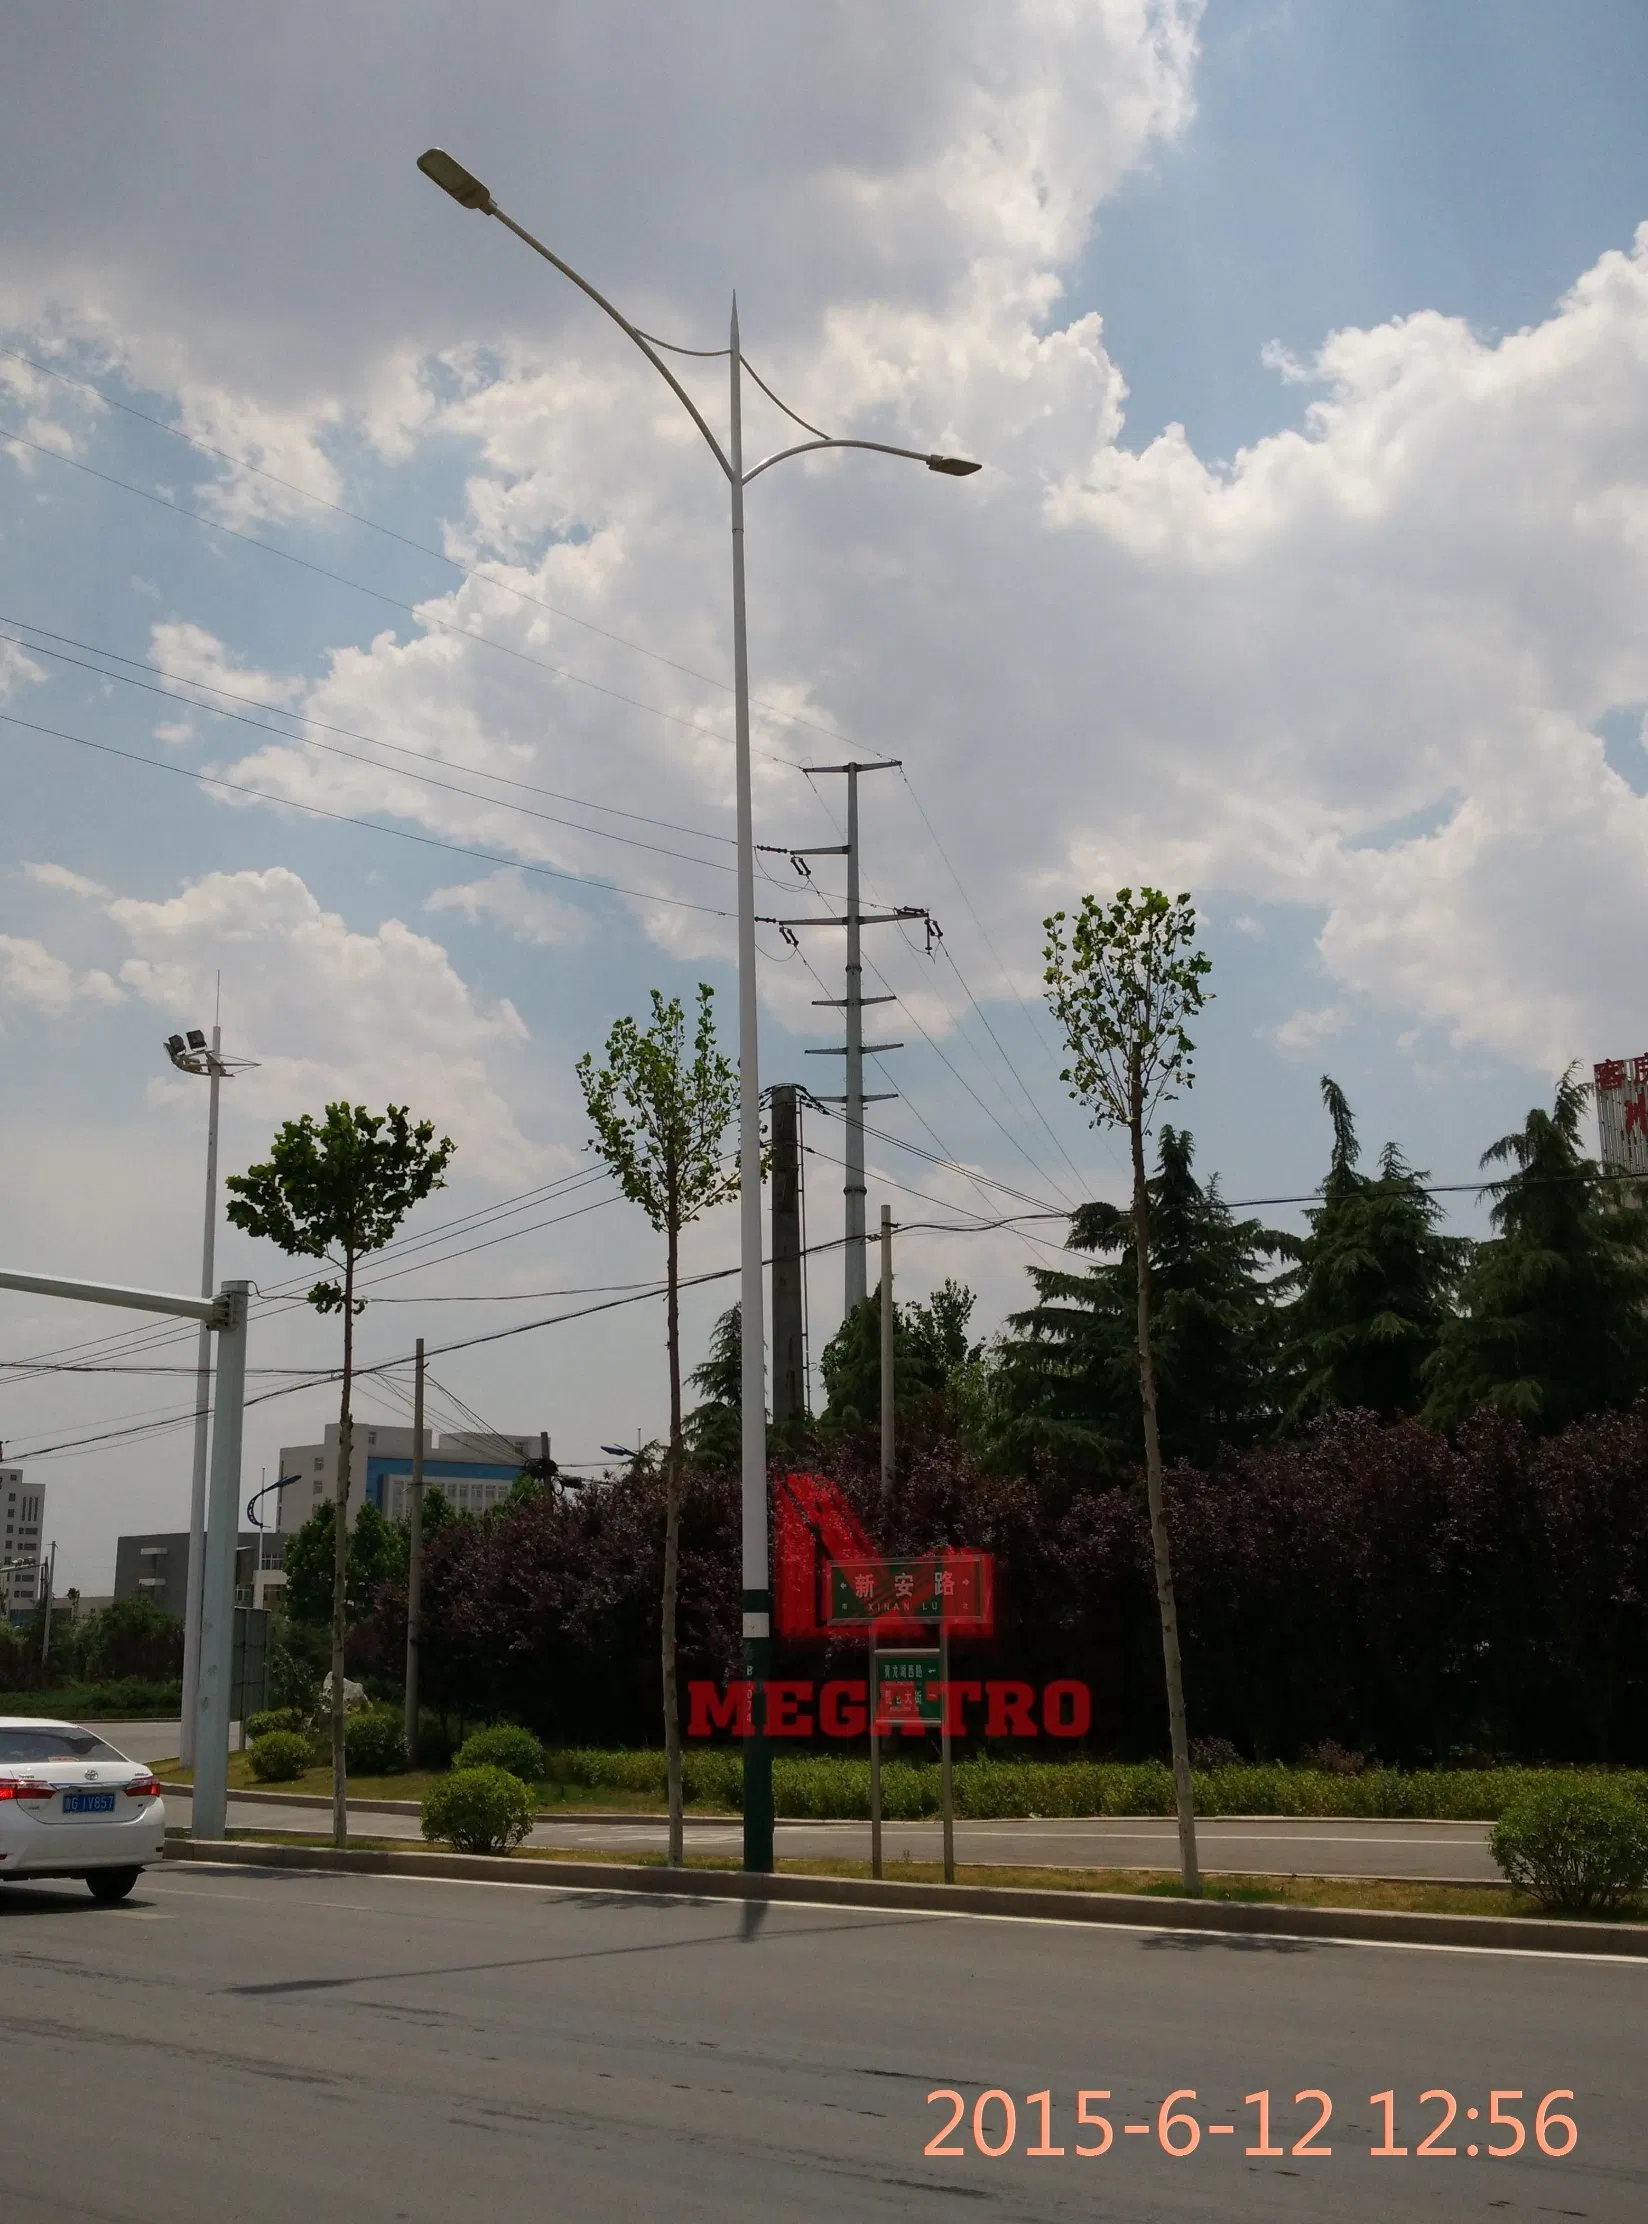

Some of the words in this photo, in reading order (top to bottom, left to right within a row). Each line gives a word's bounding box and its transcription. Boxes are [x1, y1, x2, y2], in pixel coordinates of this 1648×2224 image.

[854, 1571, 955, 1598] 新安路
[867, 1602, 910, 1612] XINAN
[922, 1601, 938, 1611] LU
